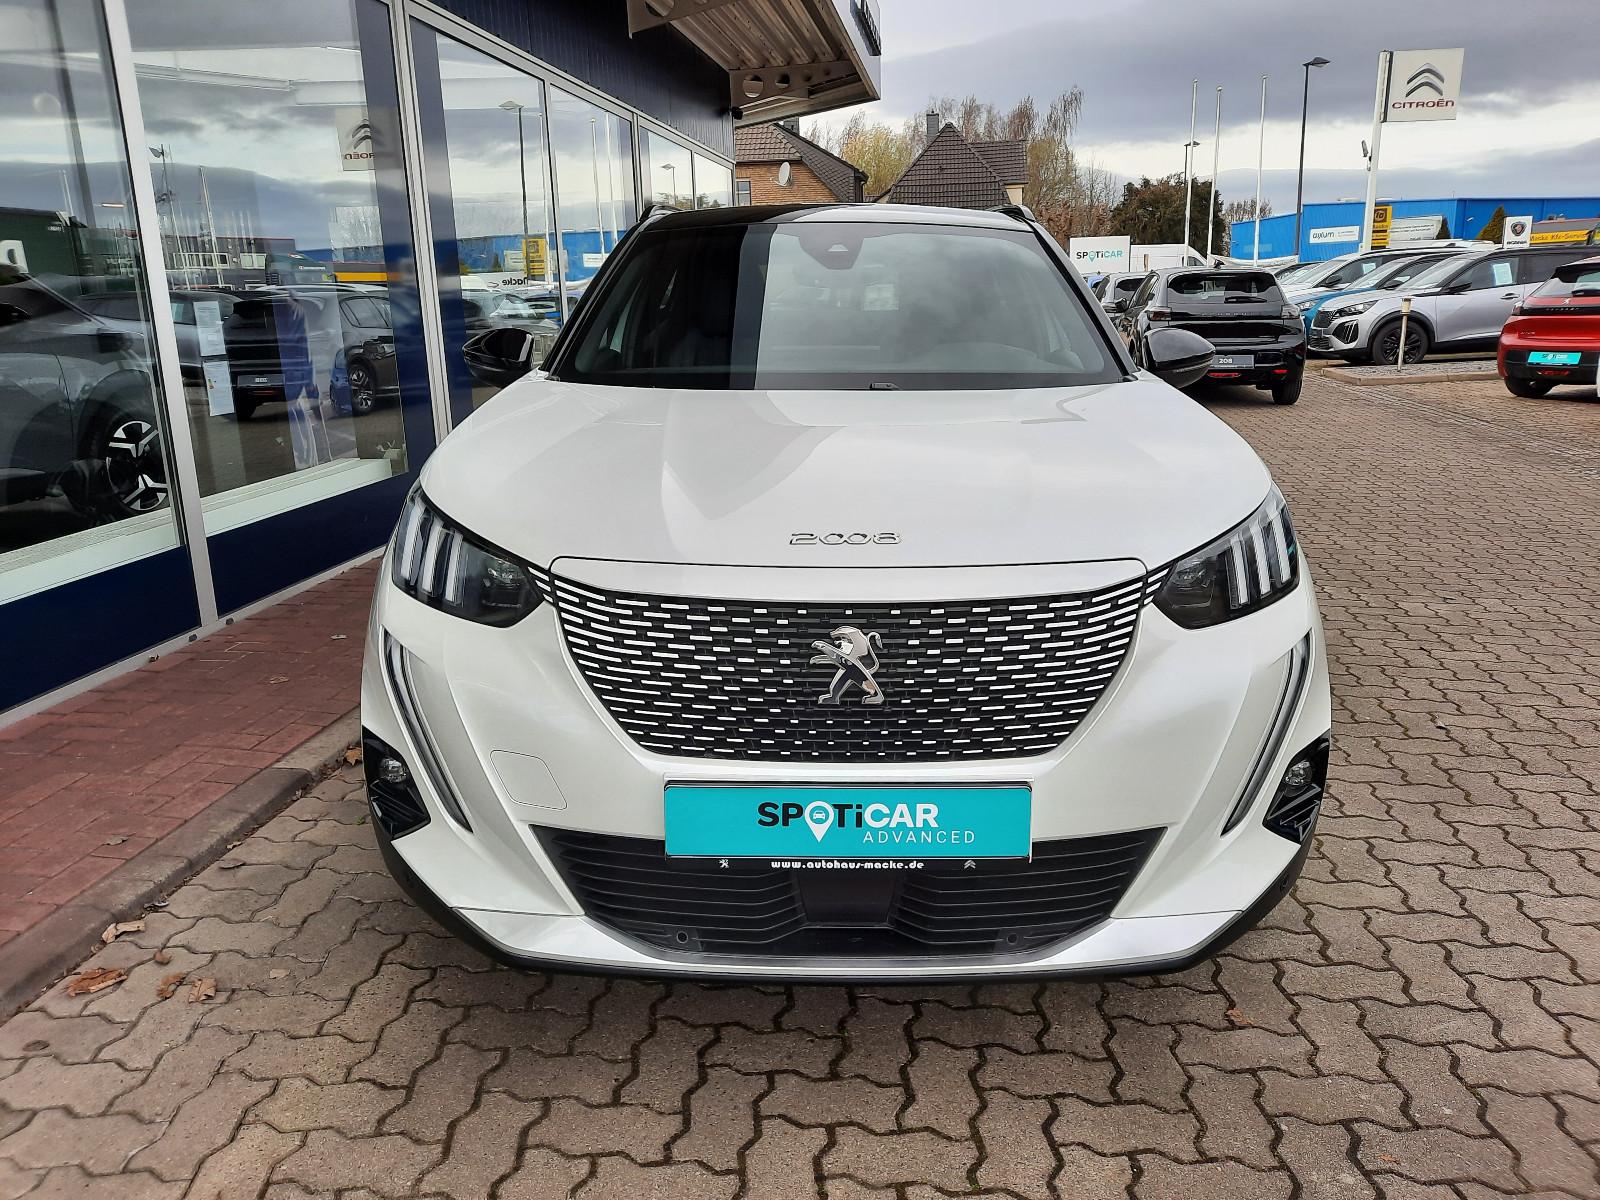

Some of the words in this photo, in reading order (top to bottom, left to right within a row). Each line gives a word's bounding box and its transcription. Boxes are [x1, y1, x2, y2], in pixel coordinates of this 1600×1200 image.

[789, 532, 902, 546] 2008
[757, 801, 940, 842] SPOTiCAR
[862, 830, 976, 844] ADVANCED
[770, 859, 925, 869] www.autohaus-macke.de
